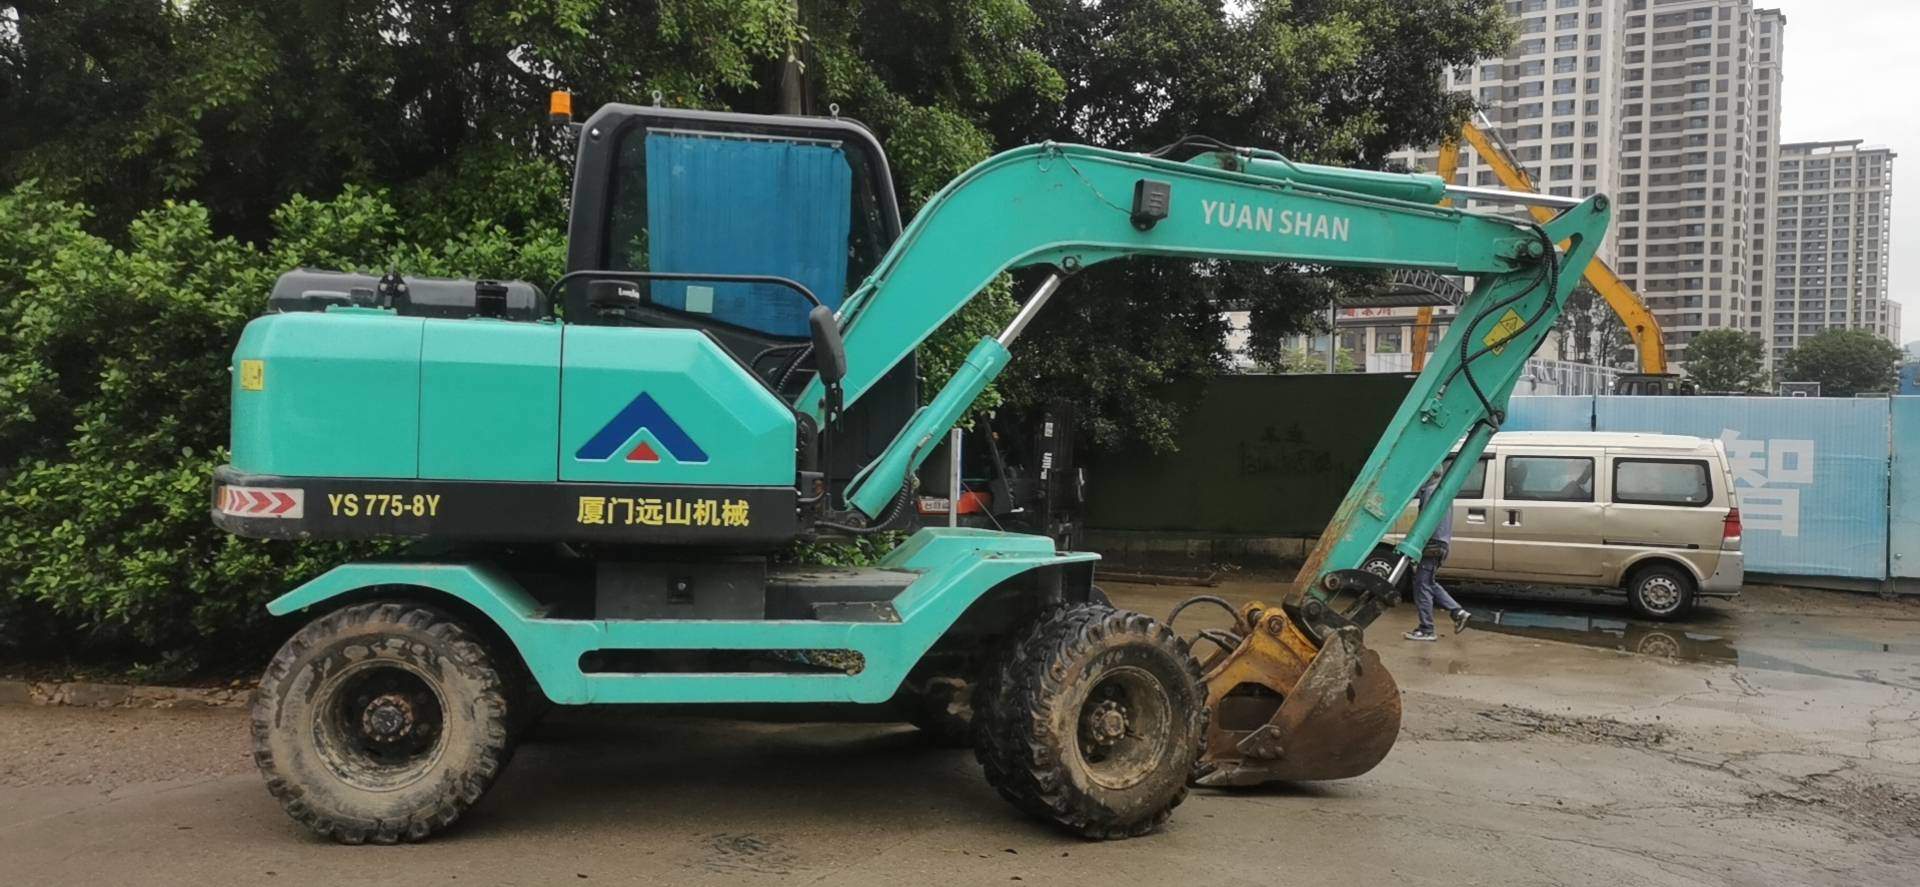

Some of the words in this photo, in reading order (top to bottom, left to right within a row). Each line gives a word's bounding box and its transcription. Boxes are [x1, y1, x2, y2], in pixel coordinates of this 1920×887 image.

[1201, 200, 1273, 232] YUAN
[1278, 210, 1350, 242] SHAN
[1721, 428, 1814, 537] 智
[327, 493, 359, 517] YS
[364, 494, 441, 517] 775-8Y
[576, 495, 750, 527] 厦门远山机械
